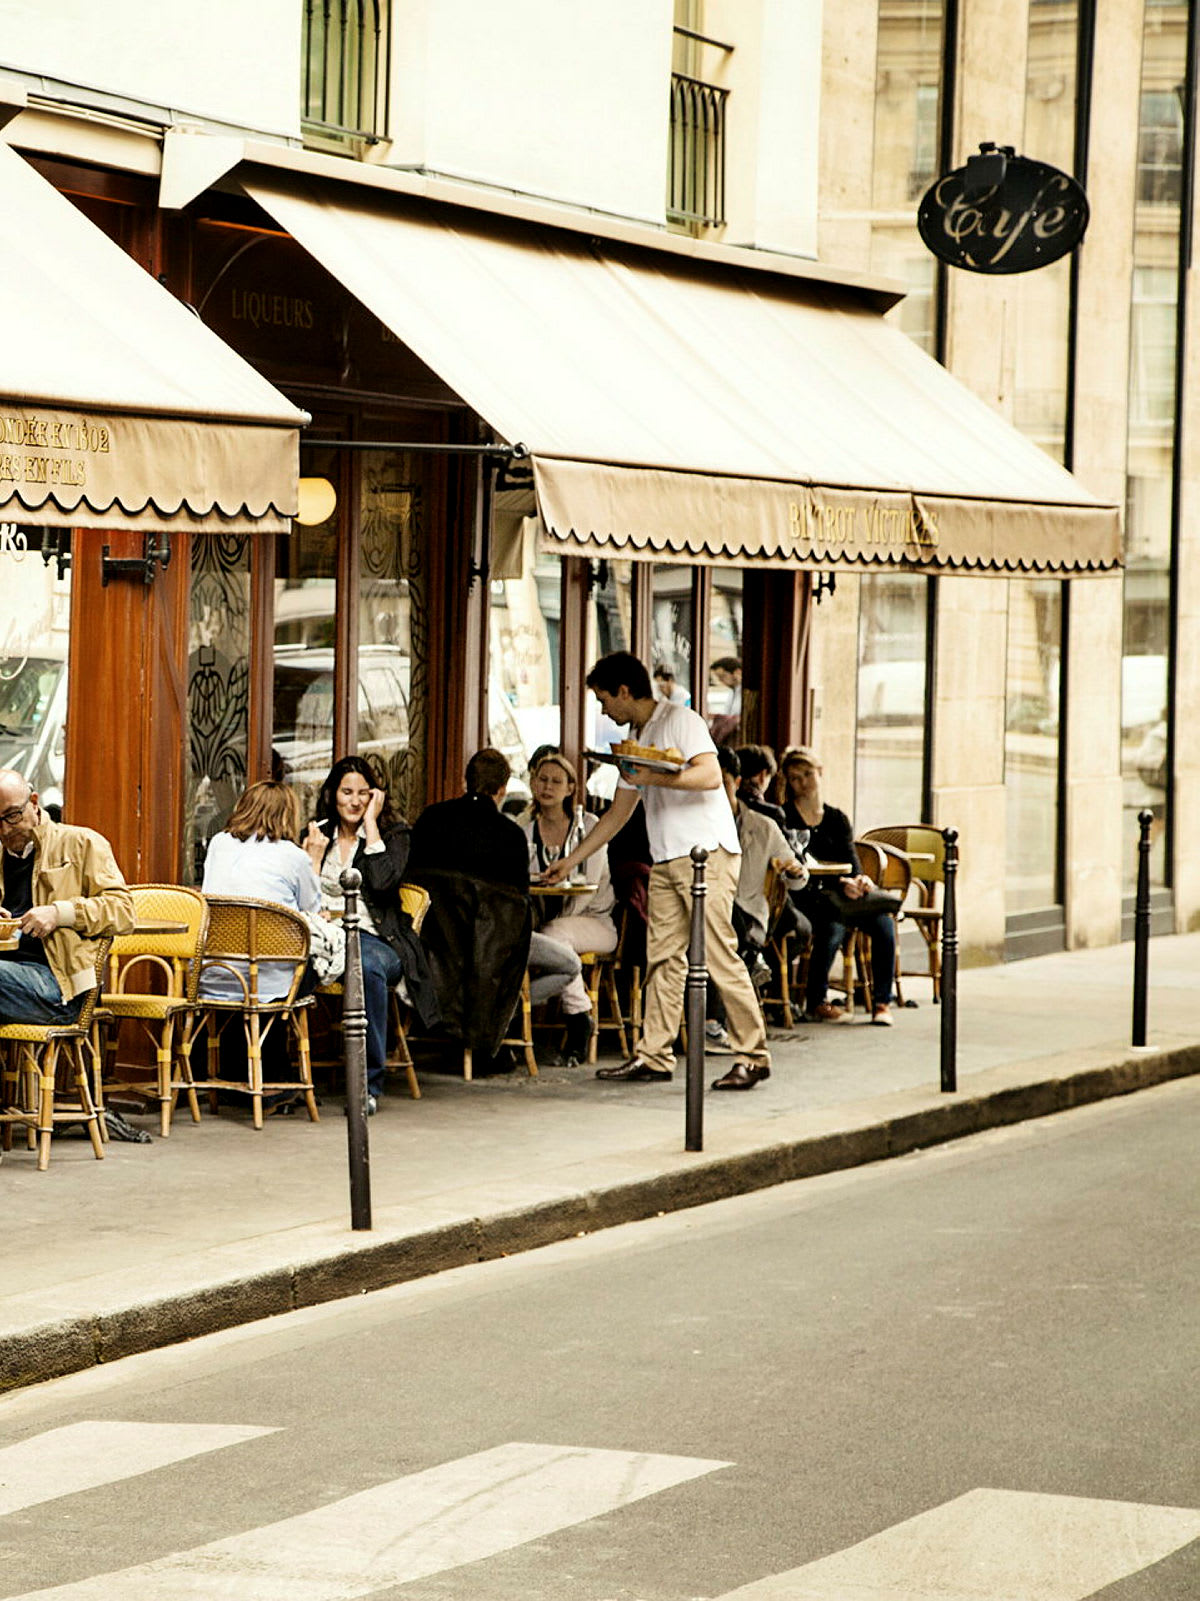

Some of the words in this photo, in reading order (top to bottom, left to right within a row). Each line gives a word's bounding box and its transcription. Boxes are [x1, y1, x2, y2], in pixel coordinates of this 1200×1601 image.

[231, 288, 314, 329] LIQUEURS
[50, 422, 74, 450] EN
[24, 456, 49, 484] EN
[51, 458, 87, 487] FILS
